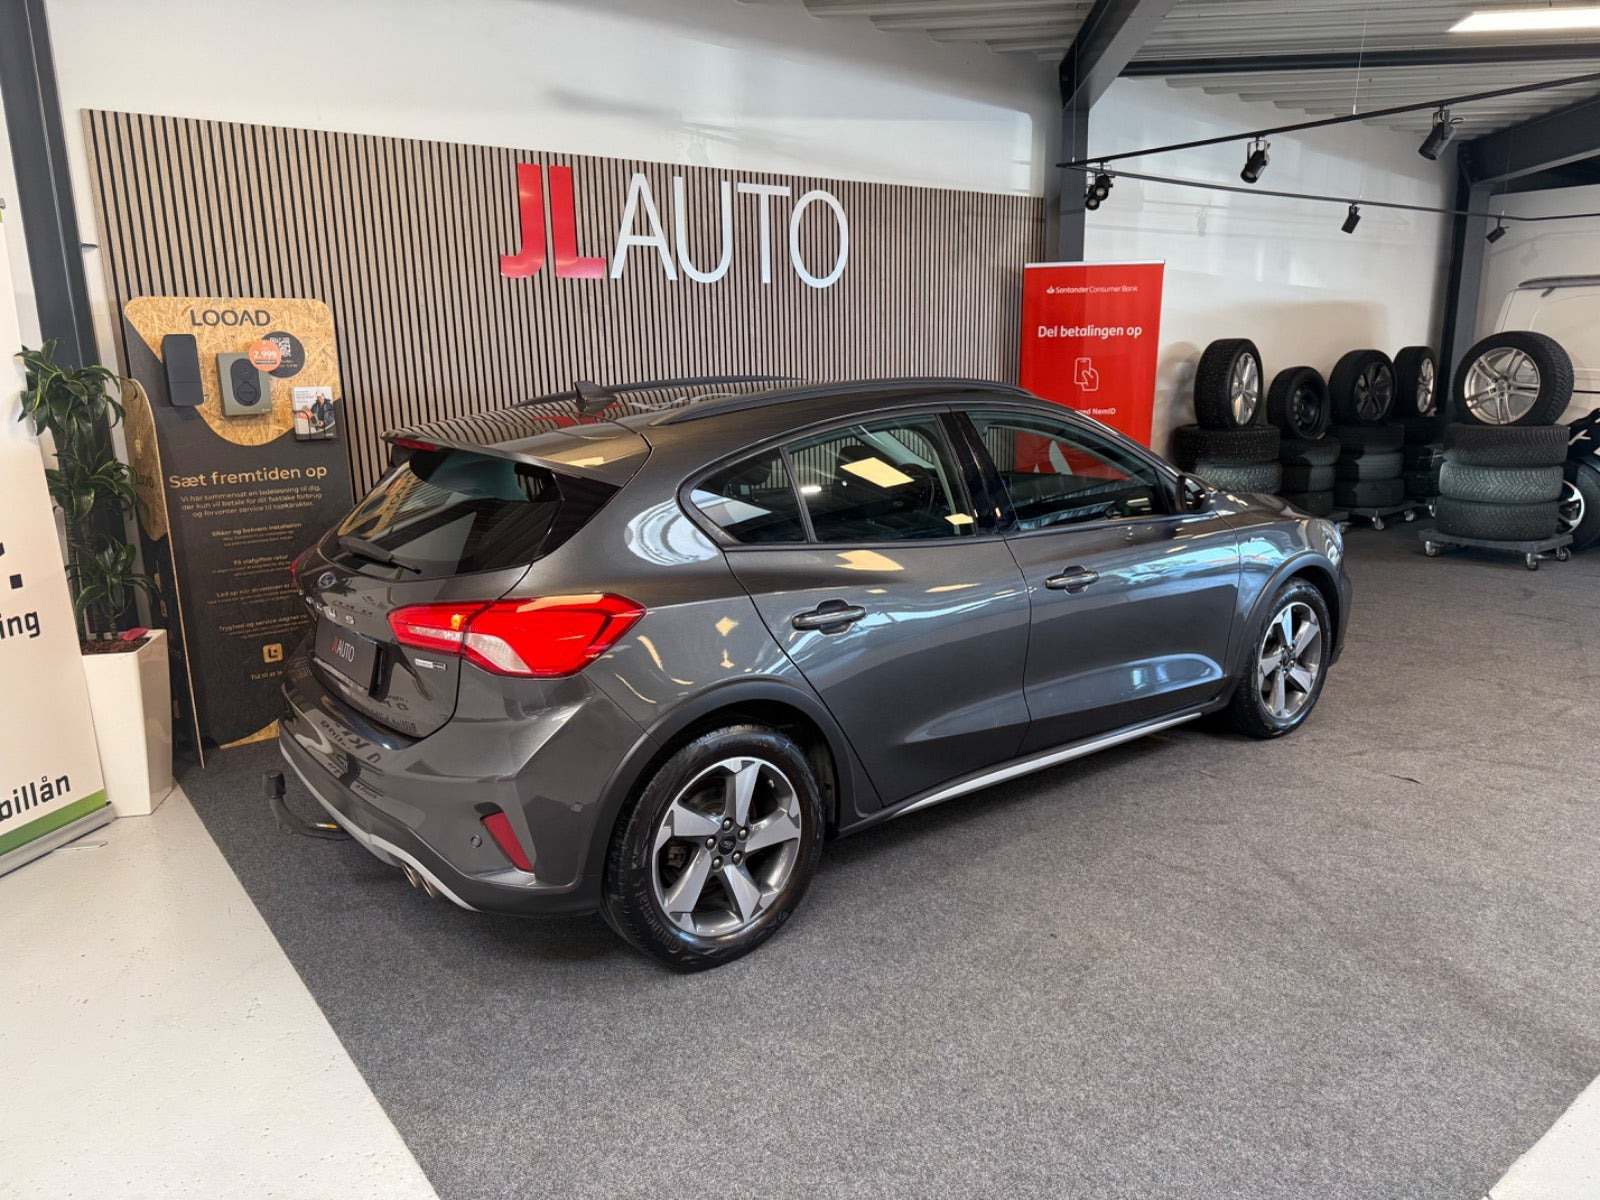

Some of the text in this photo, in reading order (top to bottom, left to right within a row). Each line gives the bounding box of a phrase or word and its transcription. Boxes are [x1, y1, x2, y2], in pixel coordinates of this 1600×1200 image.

[1038, 324, 1142, 340] Del betalingen op
[169, 474, 207, 489] Sæt
[211, 466, 301, 485] fremtiden
[305, 465, 327, 479] op
